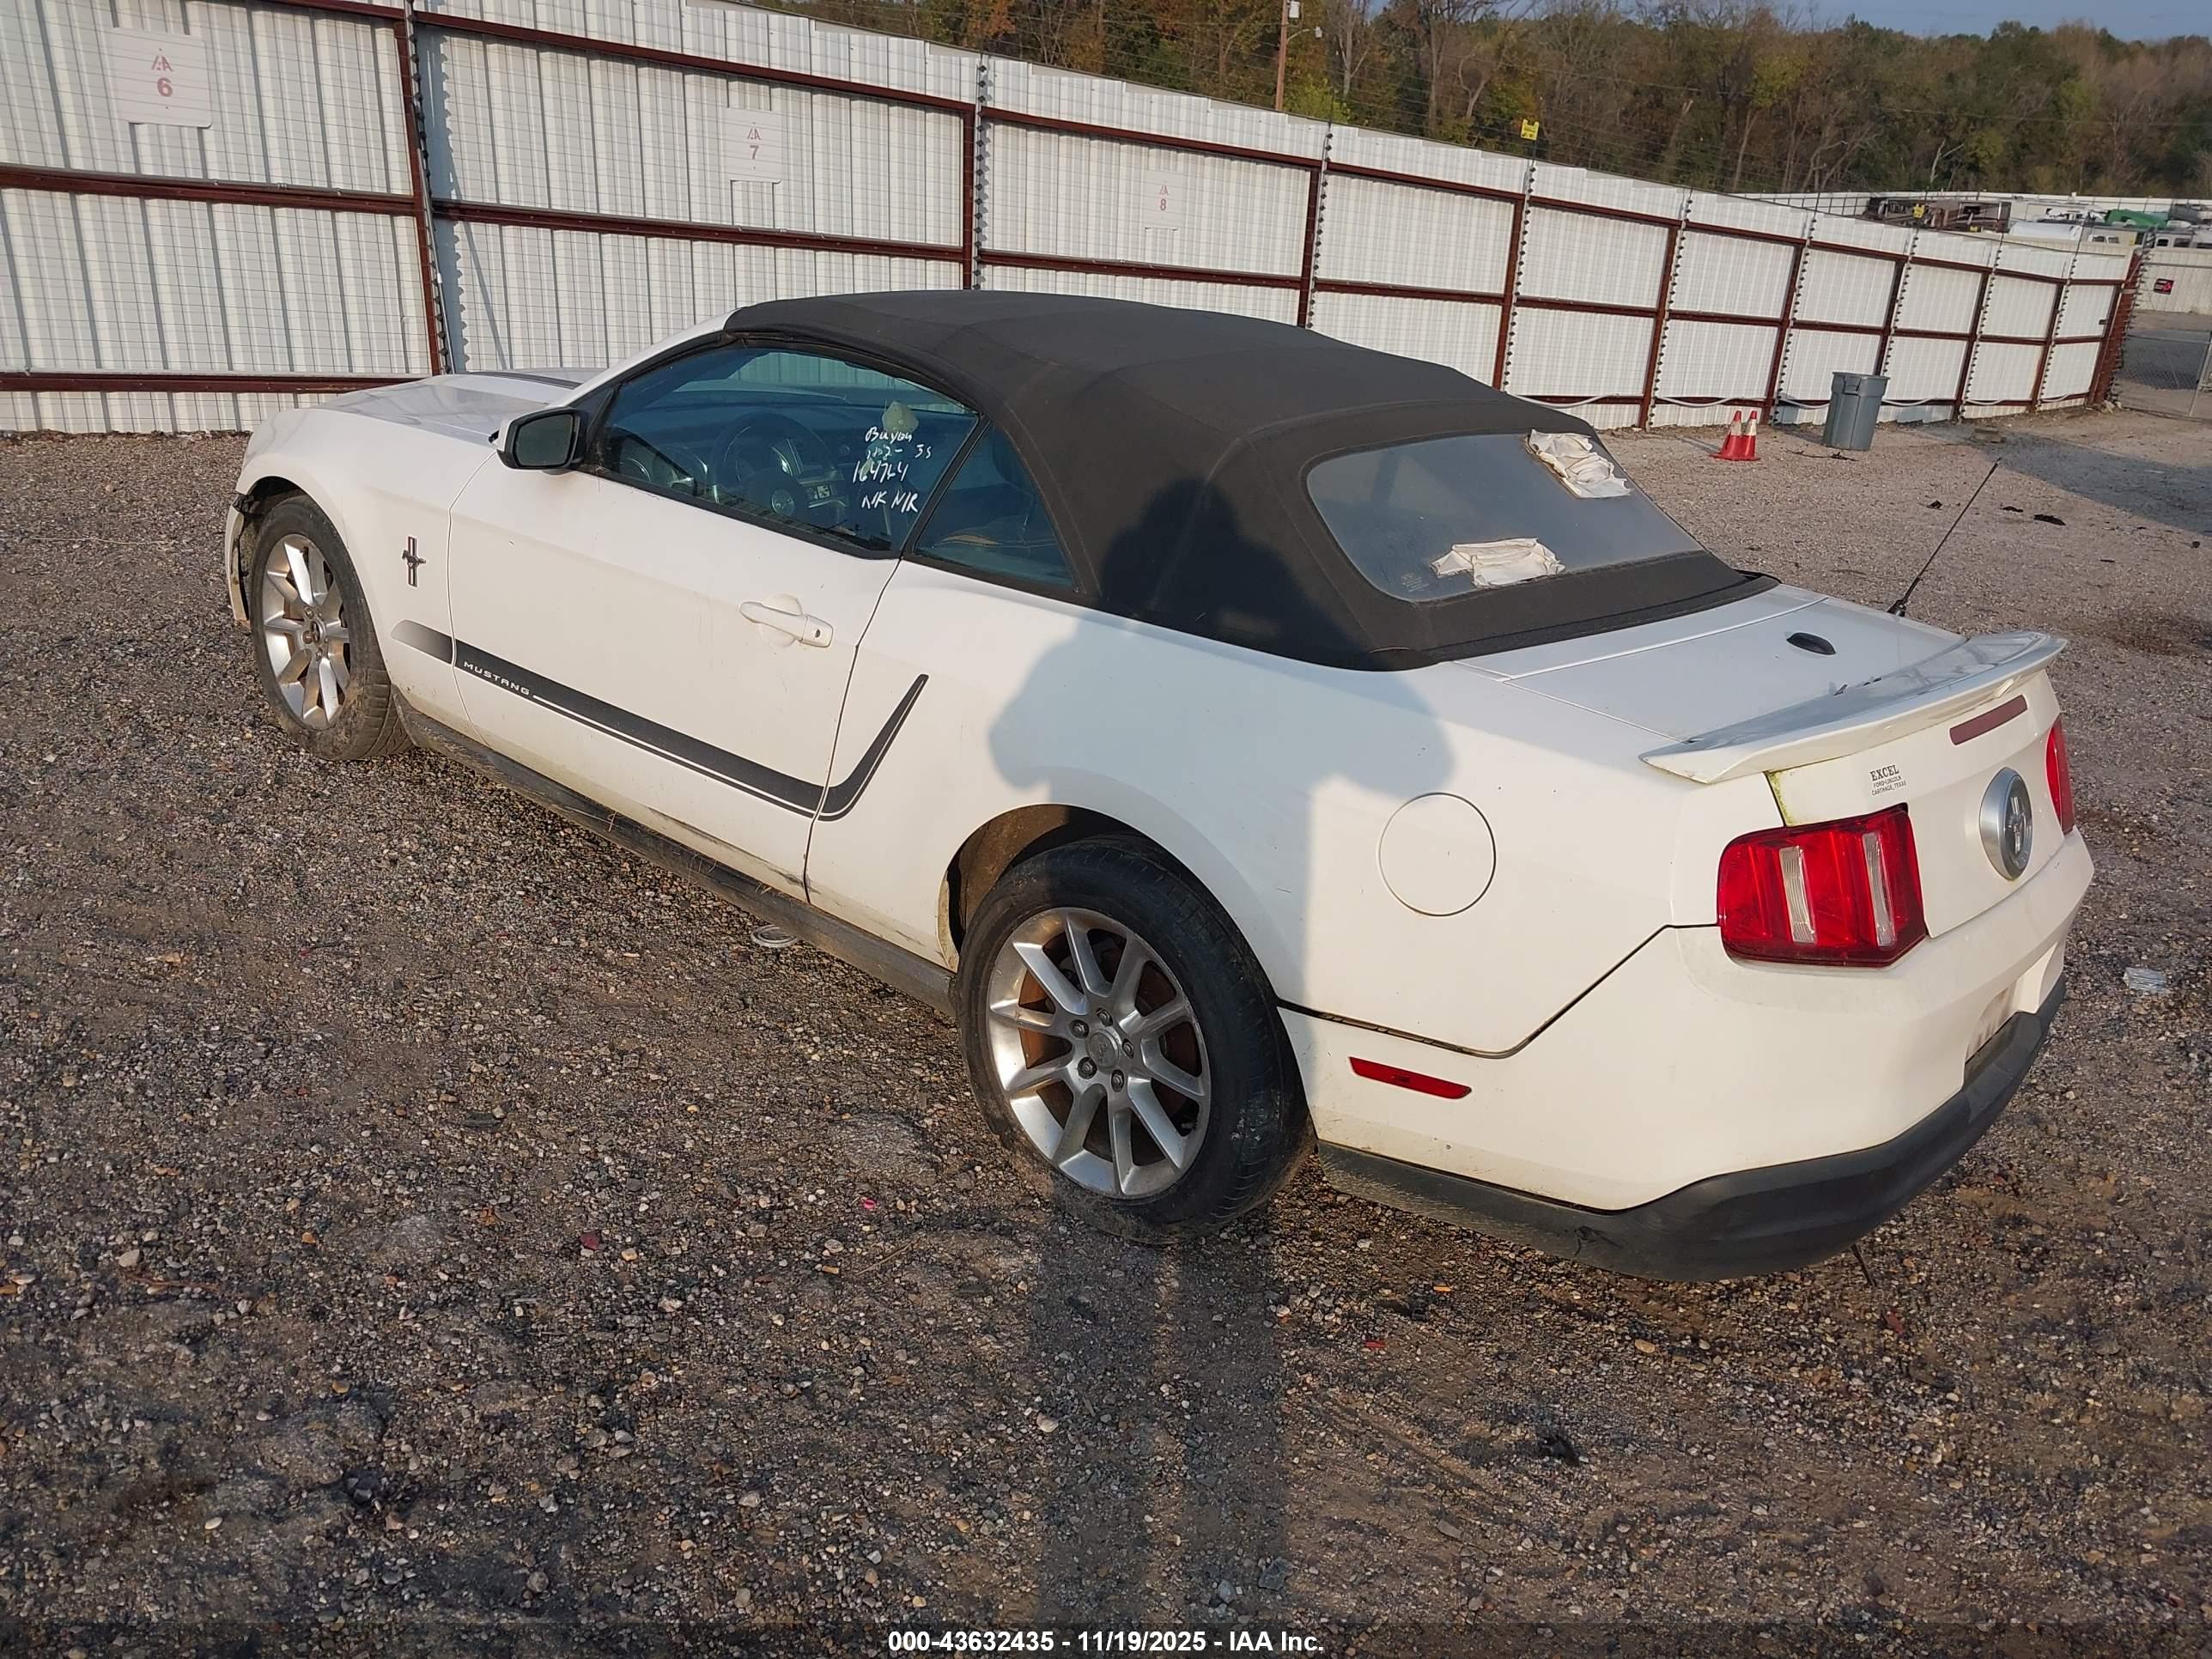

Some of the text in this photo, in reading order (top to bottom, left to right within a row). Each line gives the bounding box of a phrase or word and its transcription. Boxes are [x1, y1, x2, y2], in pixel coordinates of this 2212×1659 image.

[157, 77, 173, 98] 6
[749, 144, 760, 160] 7
[1160, 198, 1167, 211] 8
[464, 661, 530, 696] MUSTANG
[1869, 764, 1899, 781] EXCEL
